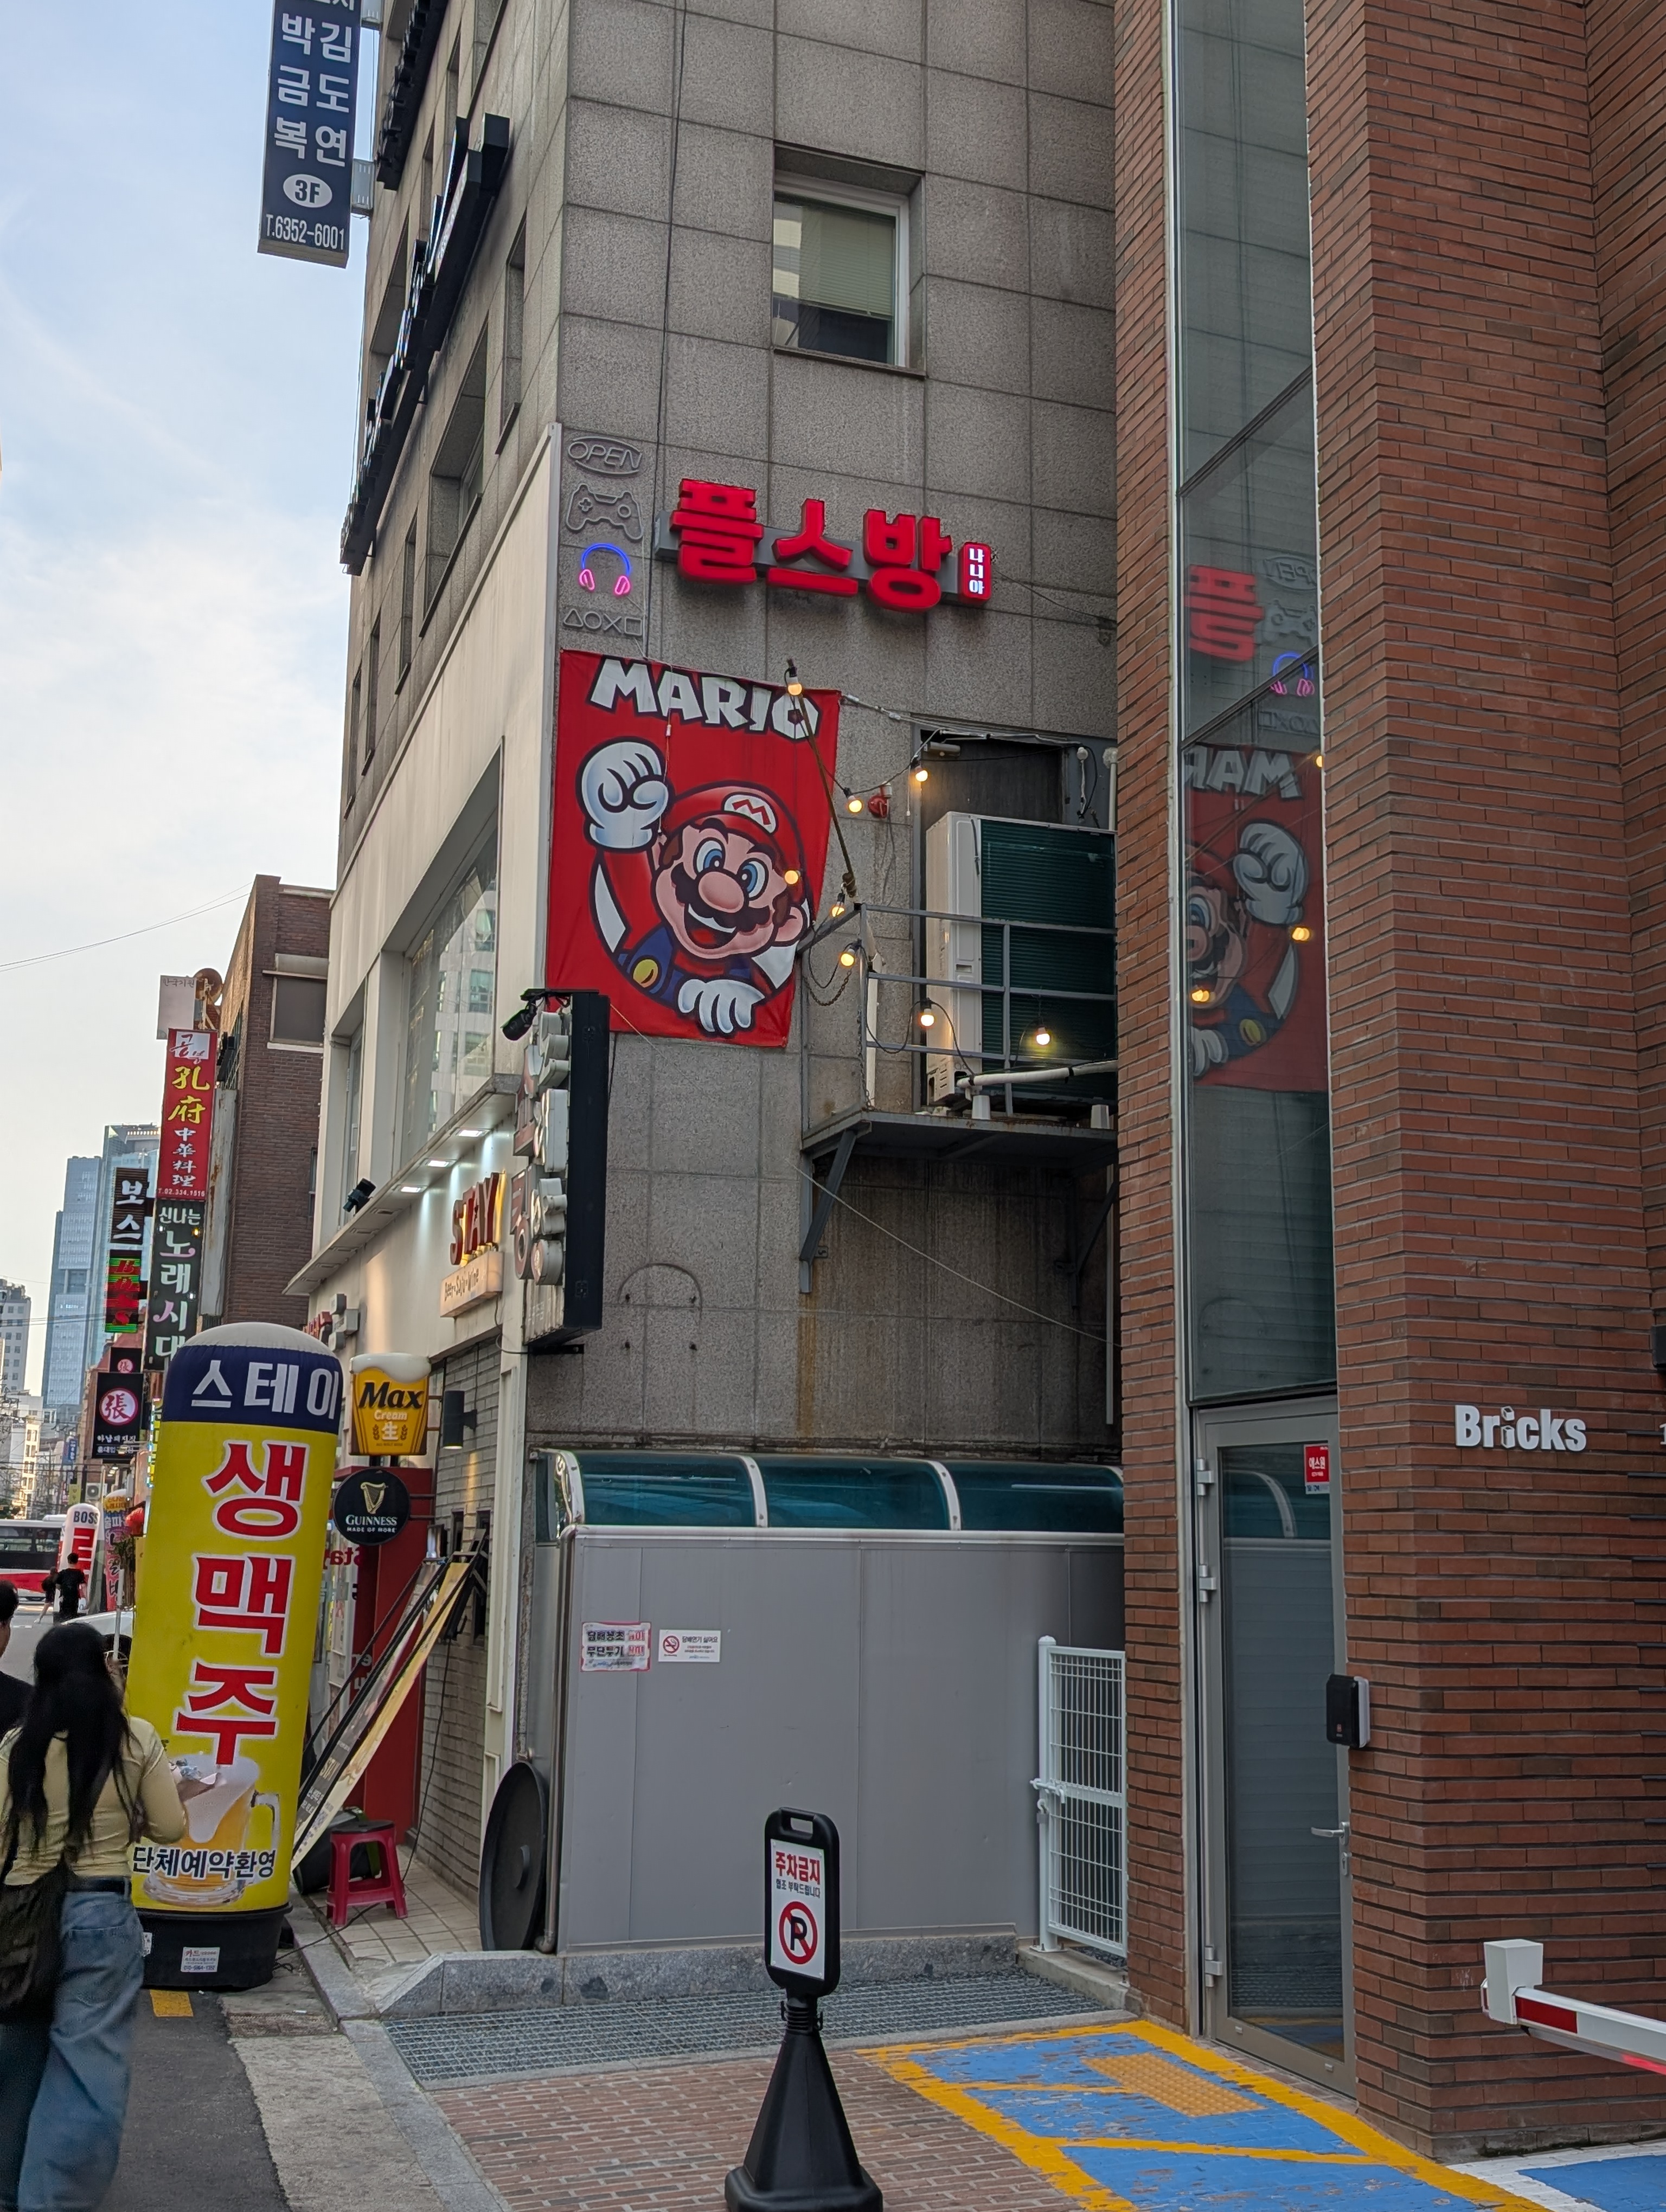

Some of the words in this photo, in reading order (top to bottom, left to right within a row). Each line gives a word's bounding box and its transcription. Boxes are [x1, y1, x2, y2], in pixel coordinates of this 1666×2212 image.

[274, 13, 315, 159] 박금복
[315, 22, 353, 168] 김도연
[294, 179, 321, 203] 3F
[266, 214, 345, 250] T.6352-6001
[567, 441, 642, 472] OPEN
[670, 478, 953, 613] 플스방
[969, 548, 984, 594] 나니아
[591, 658, 819, 740] MARIO
[732, 799, 772, 825] M
[168, 1065, 210, 1124] 孔府
[172, 1127, 197, 1187] 中華料理
[113, 1180, 145, 1240] 보스
[159, 1207, 201, 1225] 신나는
[450, 1172, 499, 1265] STAY
[153, 1230, 196, 1358] 노래시대
[191, 1360, 339, 1420] 스테이
[358, 1381, 425, 1409] Max
[374, 1410, 408, 1420] Cream
[382, 1422, 399, 1440] 生
[1454, 1404, 1587, 1452] Bricks
[73, 1511, 99, 1525] BOSS
[345, 1514, 398, 1526] GUINNESS
[176, 1442, 307, 1766] 생맥주
[132, 1846, 276, 1879] 단체예약환영
[776, 1851, 820, 1886] 주차금지
[776, 1878, 786, 1890] 협조
[789, 1881, 821, 1899] 부탁드립니다
